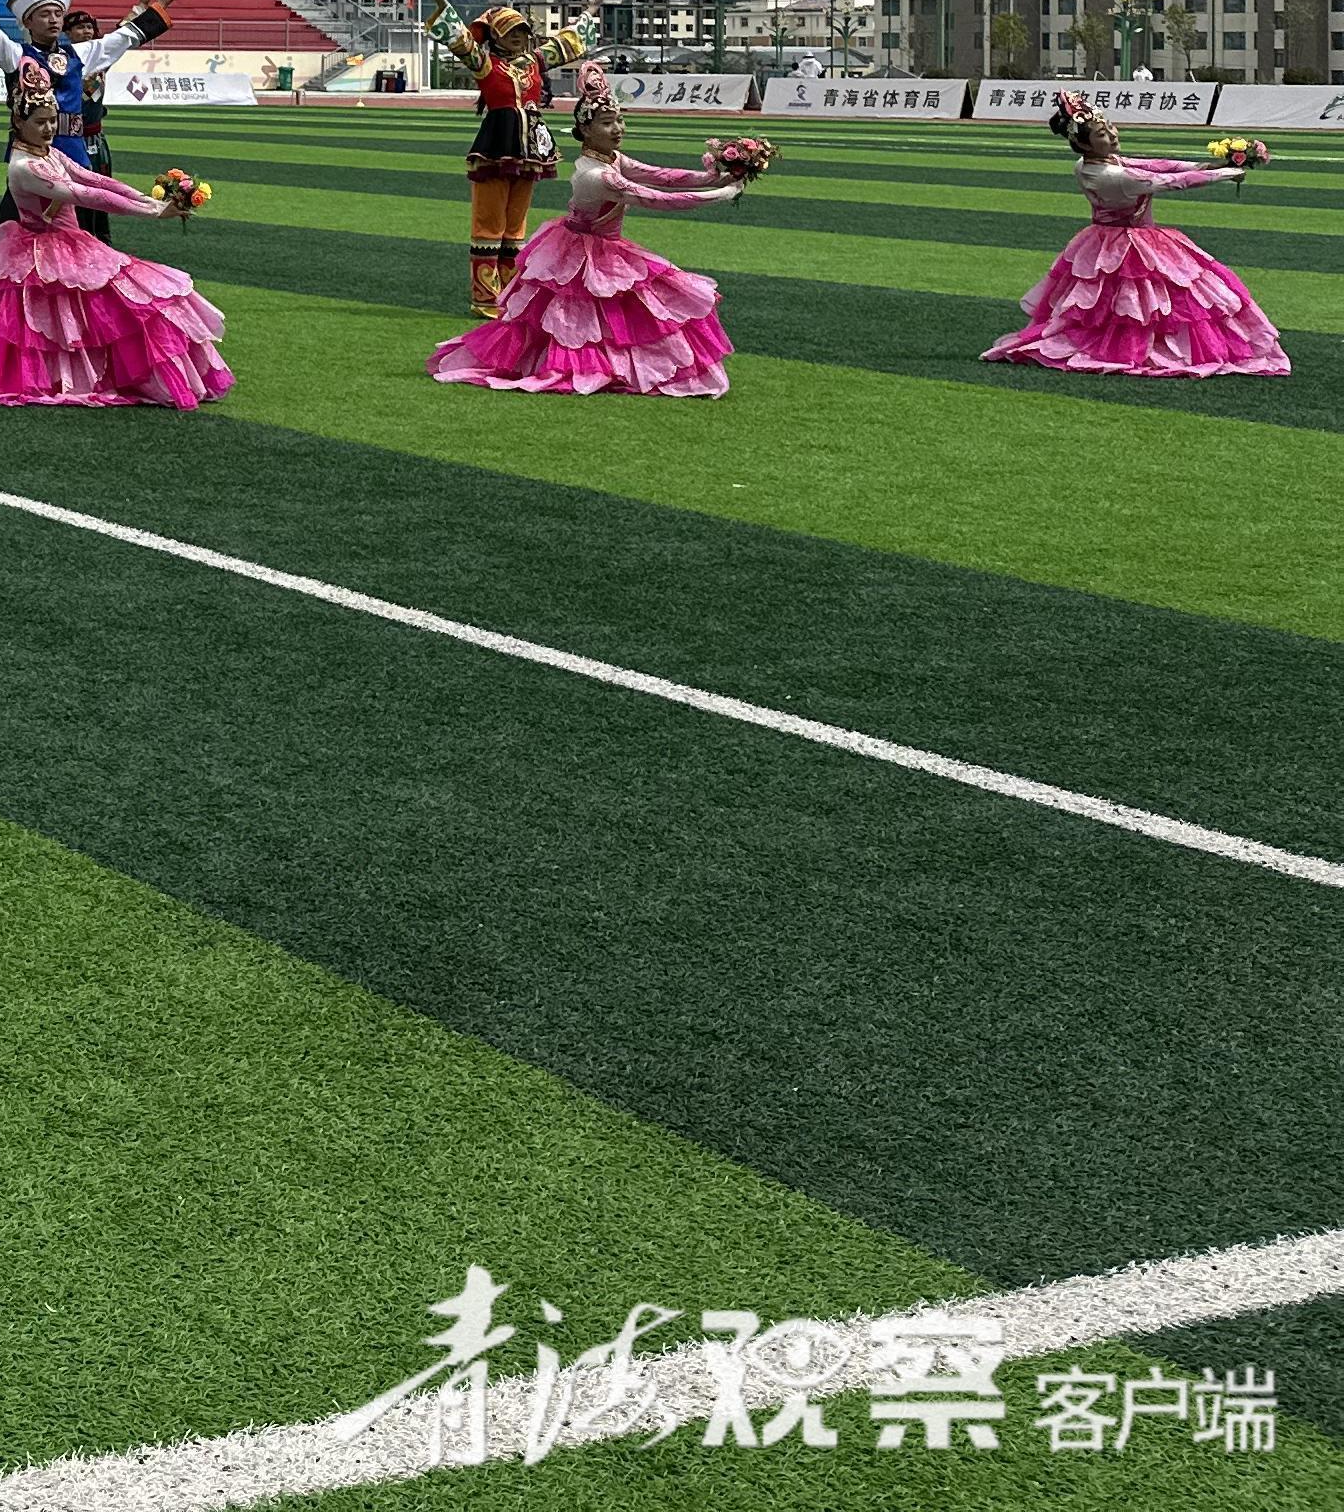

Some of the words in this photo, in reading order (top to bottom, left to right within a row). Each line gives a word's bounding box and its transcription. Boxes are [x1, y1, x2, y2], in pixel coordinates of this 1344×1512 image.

[150, 76, 205, 93] 青海银行
[823, 88, 941, 109] 青海省体育局
